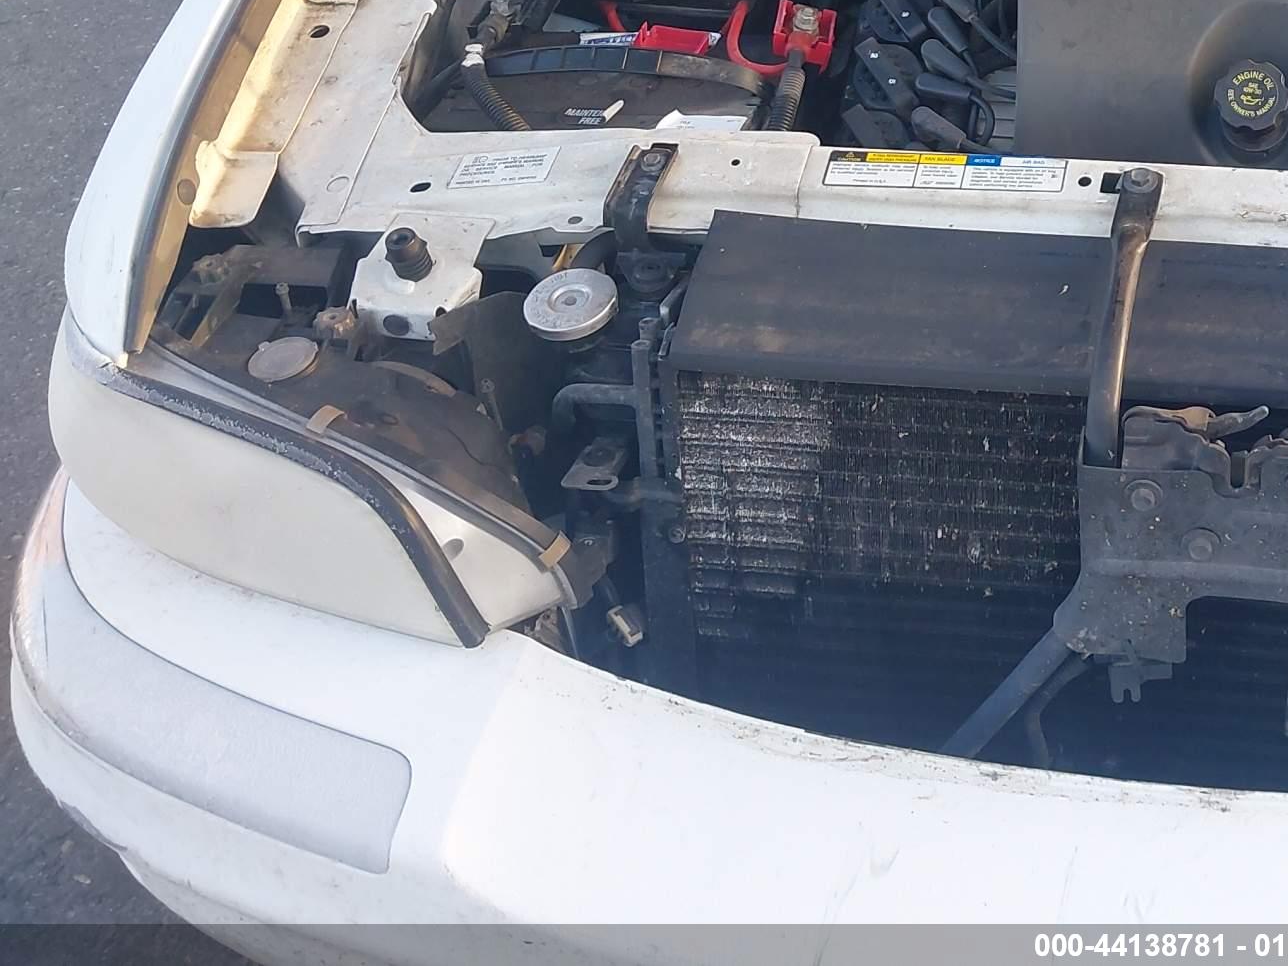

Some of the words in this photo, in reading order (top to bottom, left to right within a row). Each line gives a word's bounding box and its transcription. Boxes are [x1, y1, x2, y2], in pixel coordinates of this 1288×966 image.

[1232, 70, 1265, 85] ENGINE
[1263, 78, 1275, 91] OIL
[1227, 88, 1235, 102] SEE
[1230, 101, 1256, 117] OWNER'S
[1255, 96, 1276, 116] MANUAL
[578, 117, 602, 125] FREE
